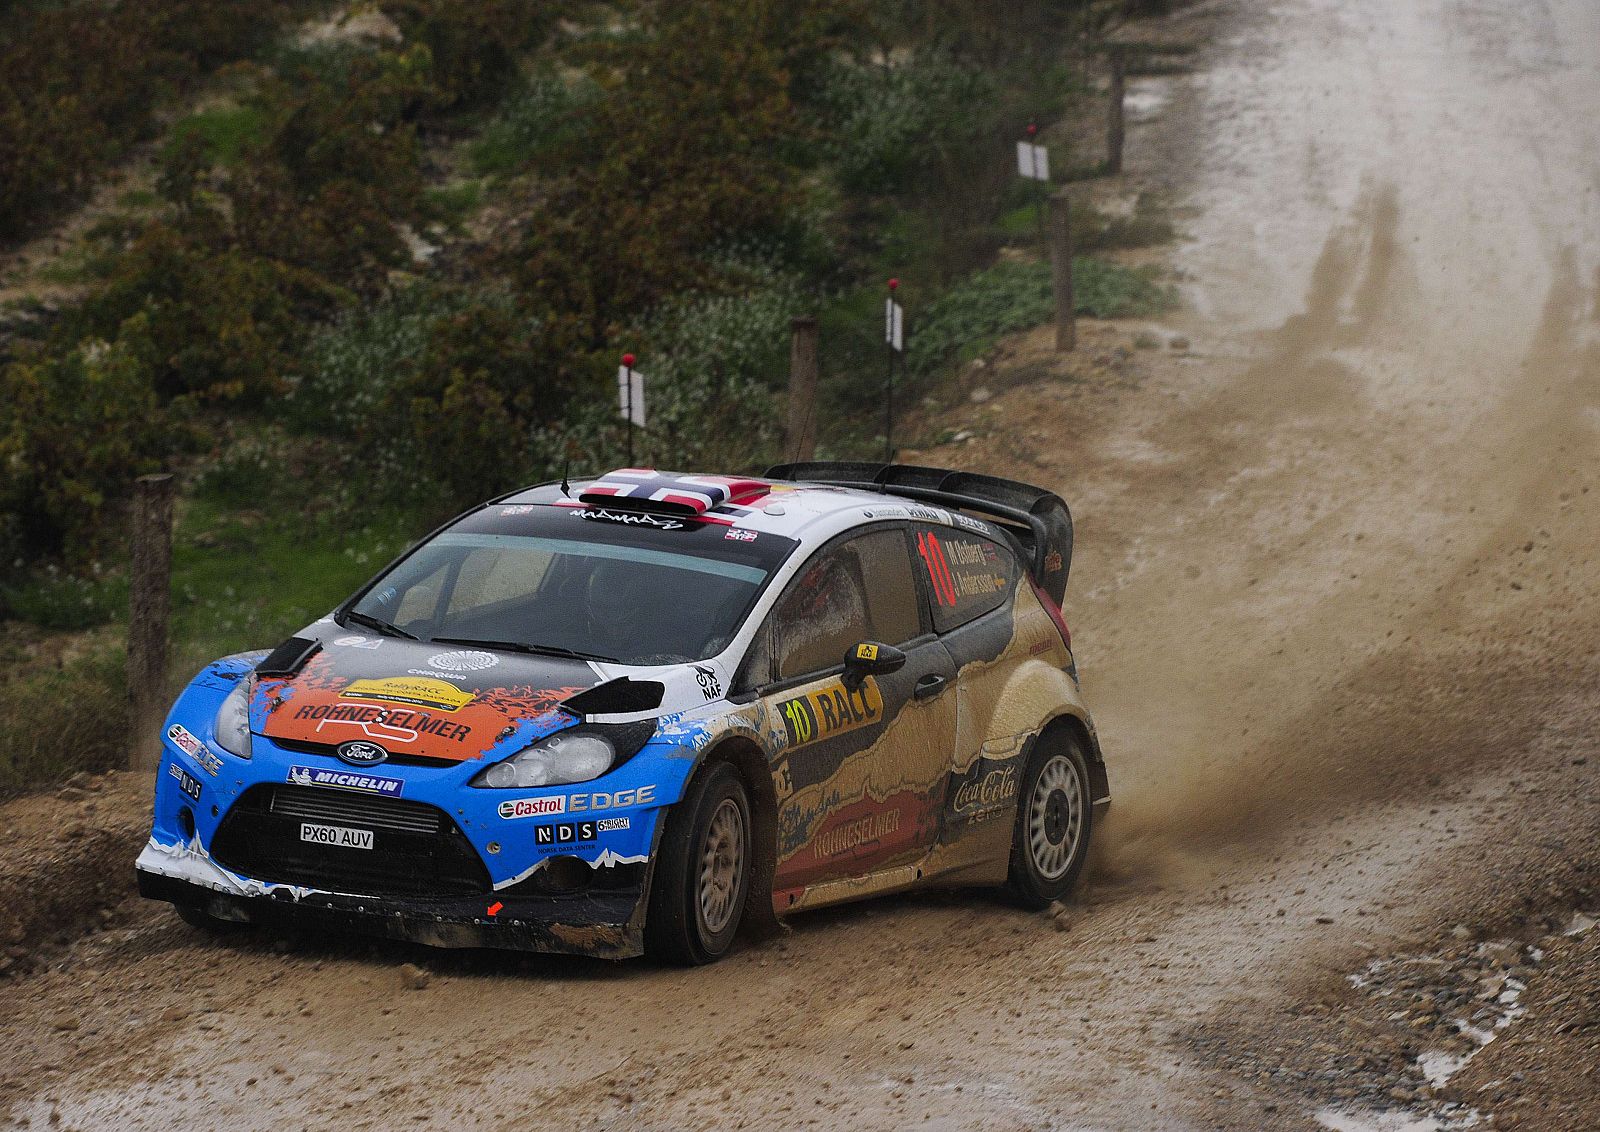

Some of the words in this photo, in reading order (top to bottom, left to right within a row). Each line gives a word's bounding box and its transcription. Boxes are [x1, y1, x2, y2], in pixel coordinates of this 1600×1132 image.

[917, 531, 956, 606] 10
[702, 683, 722, 701] NAF
[816, 681, 876, 732] RACC
[785, 700, 811, 744] 10
[346, 744, 375, 760] Ford
[315, 771, 399, 792] MICHELIN
[515, 798, 562, 816] Castrol
[569, 784, 657, 812] EDGE
[302, 825, 337, 843] PX60
[341, 830, 371, 847] AUV
